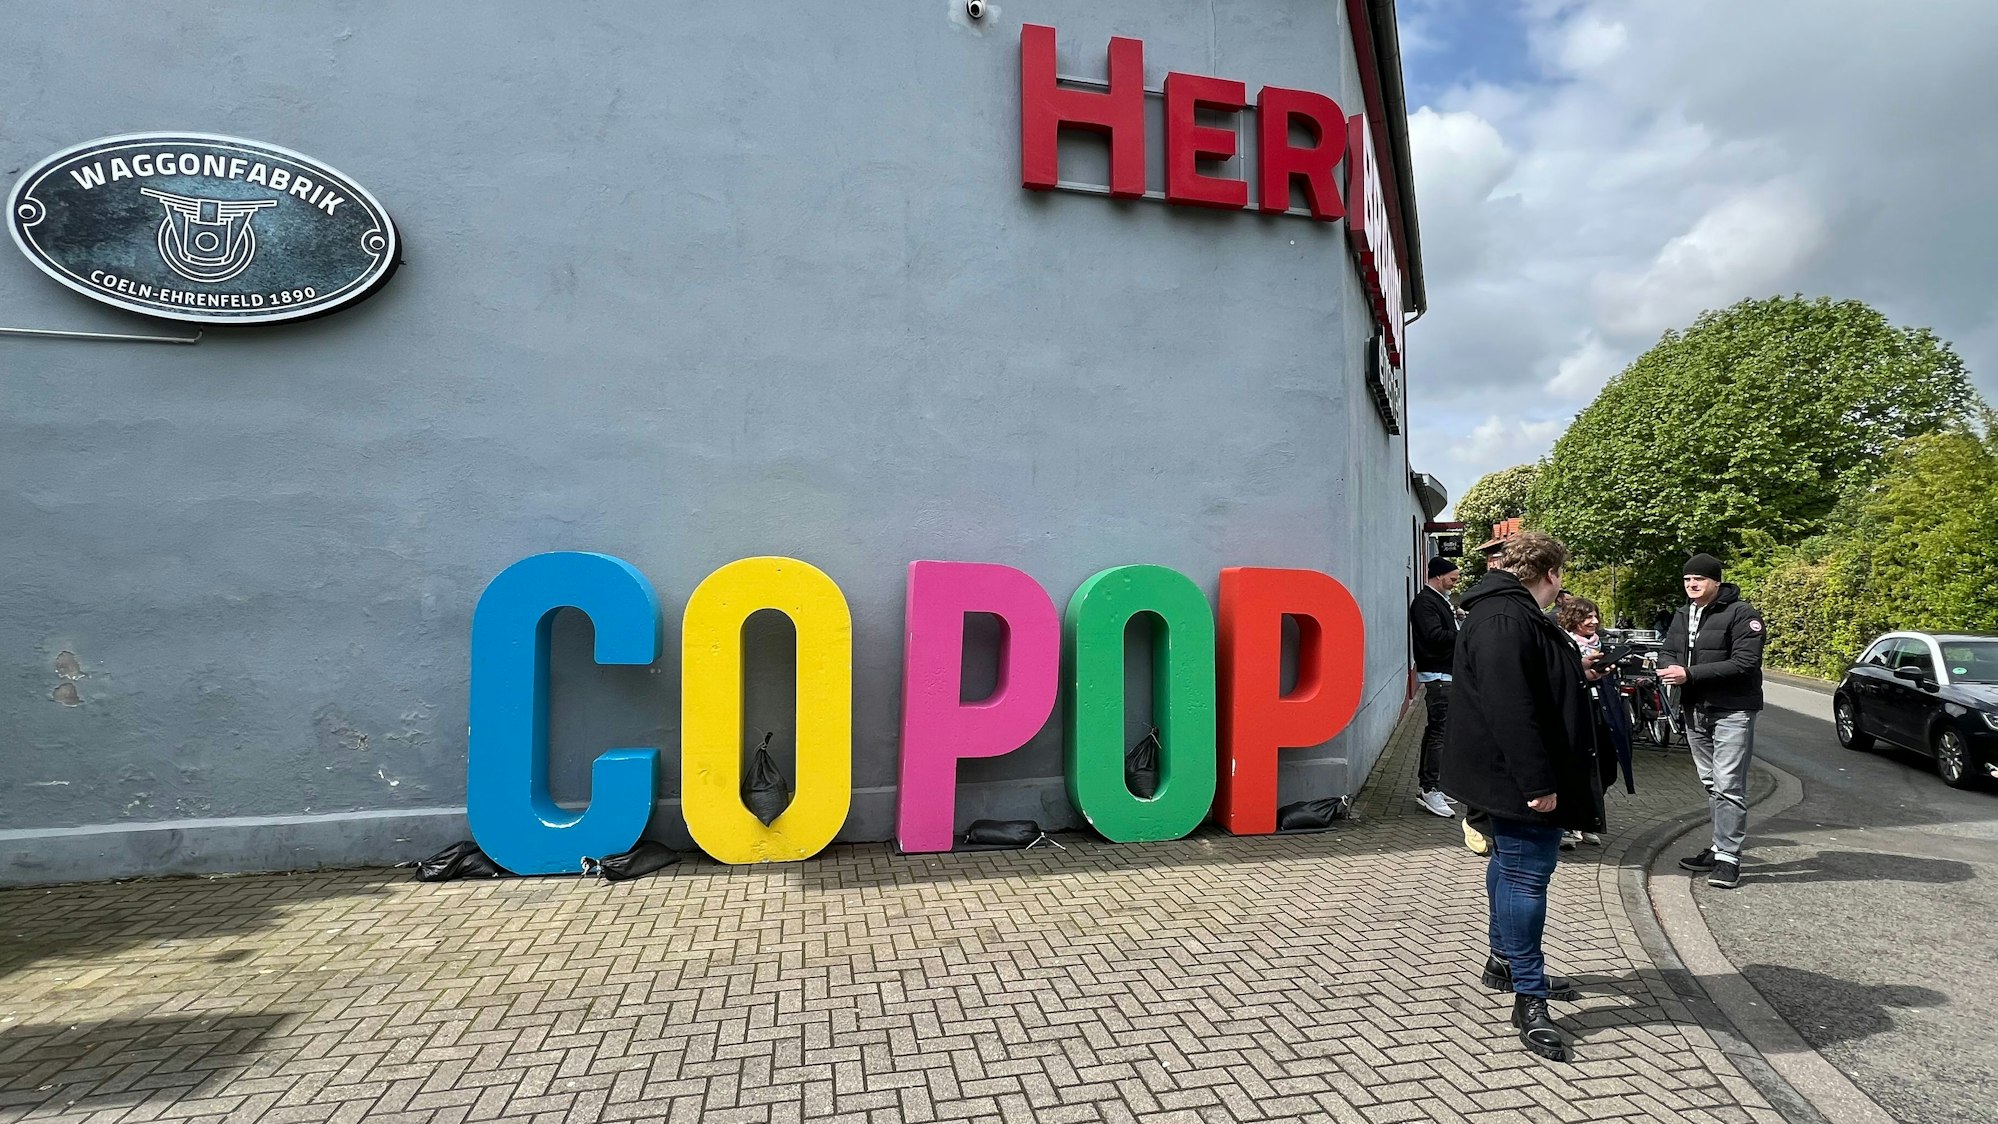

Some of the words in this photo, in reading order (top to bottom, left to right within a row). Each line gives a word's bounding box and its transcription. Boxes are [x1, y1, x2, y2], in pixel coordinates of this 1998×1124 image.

[1020, 23, 1347, 222] HER
[70, 152, 346, 216] WAGGONFABRIK
[89, 269, 264, 307] COELN-EHRENFELD
[269, 286, 317, 306] 1890
